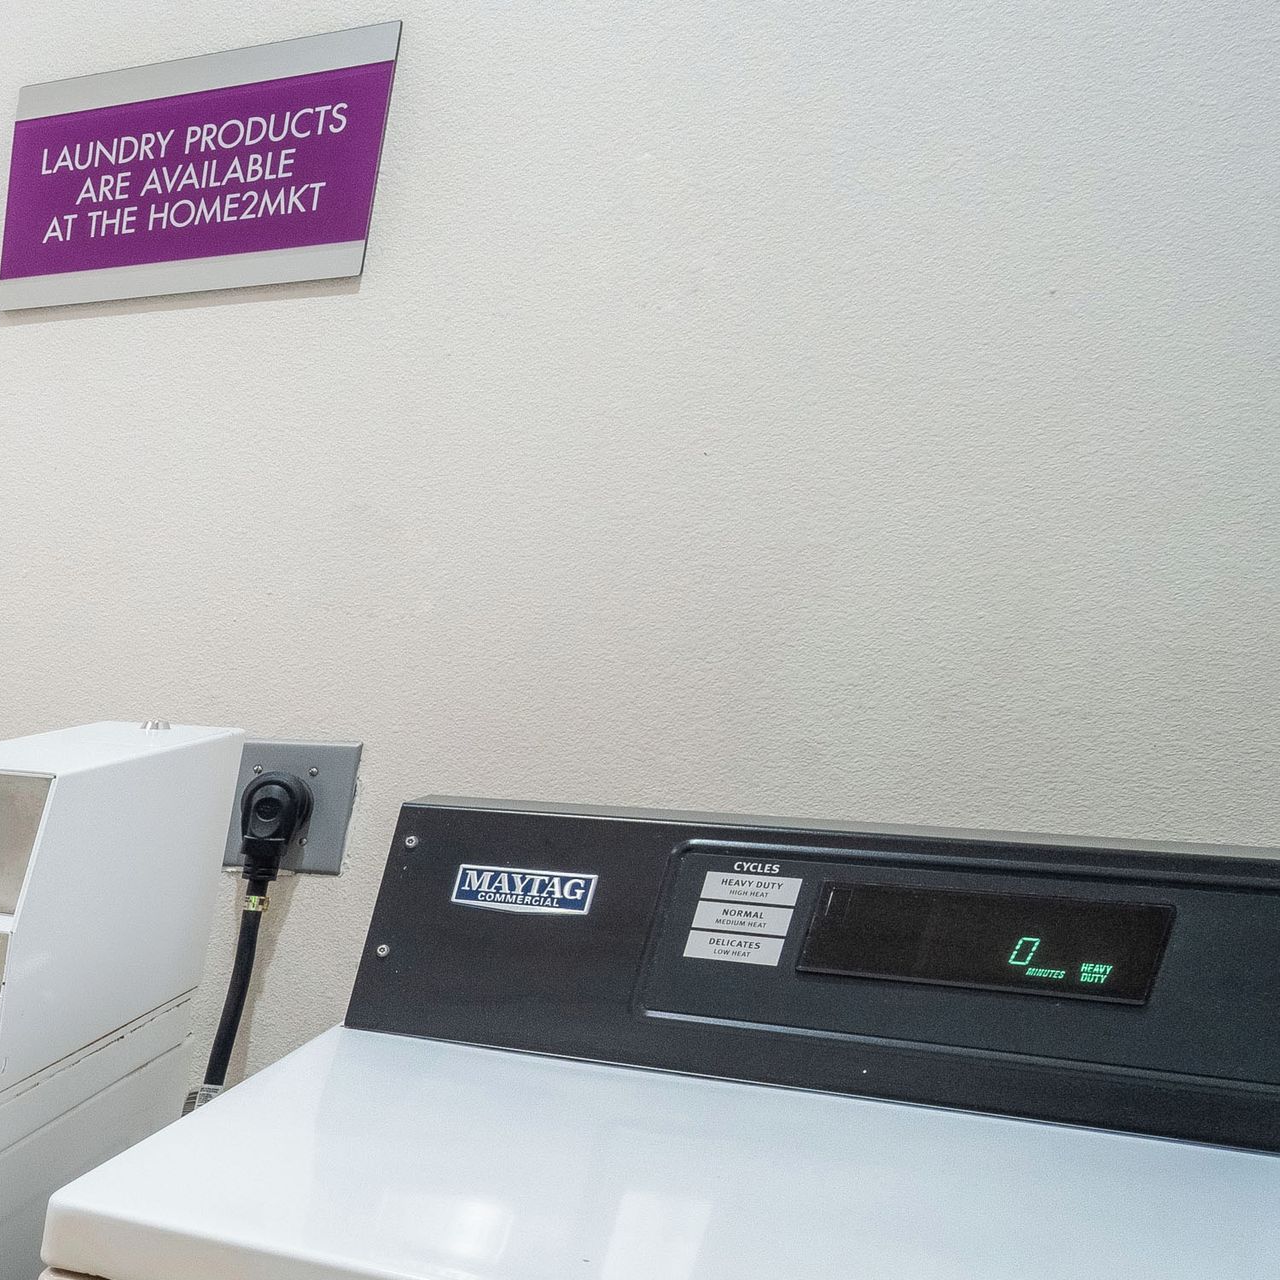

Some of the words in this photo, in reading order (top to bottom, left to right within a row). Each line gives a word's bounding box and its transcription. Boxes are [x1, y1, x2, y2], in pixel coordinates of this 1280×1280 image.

[41, 129, 175, 176] LAUNDRY
[184, 102, 348, 155] PRODUCTS
[75, 170, 132, 205] ARE
[140, 148, 296, 197] AVAILABLE
[42, 214, 78, 244] AT
[87, 206, 139, 238] THE
[147, 182, 326, 232] HOME2MKT
[733, 861, 780, 874] CYCLES
[461, 870, 585, 900] MAYTAG
[721, 878, 755, 888] HEAVY
[755, 881, 784, 890] DUTY
[477, 892, 560, 907] COMMERCIAL
[729, 889, 748, 897] HIGH
[721, 908, 765, 920] NORMAL
[715, 918, 746, 927] MEDIUM
[747, 920, 767, 929] HEAT
[708, 937, 761, 950] DELICATES
[713, 948, 730, 956] LOW
[731, 950, 752, 958] HEAT
[1008, 937, 1040, 965] 0
[1025, 967, 1066, 979] MINUTES
[1080, 962, 1113, 975] HEAVY
[1080, 973, 1108, 984] DUTY
